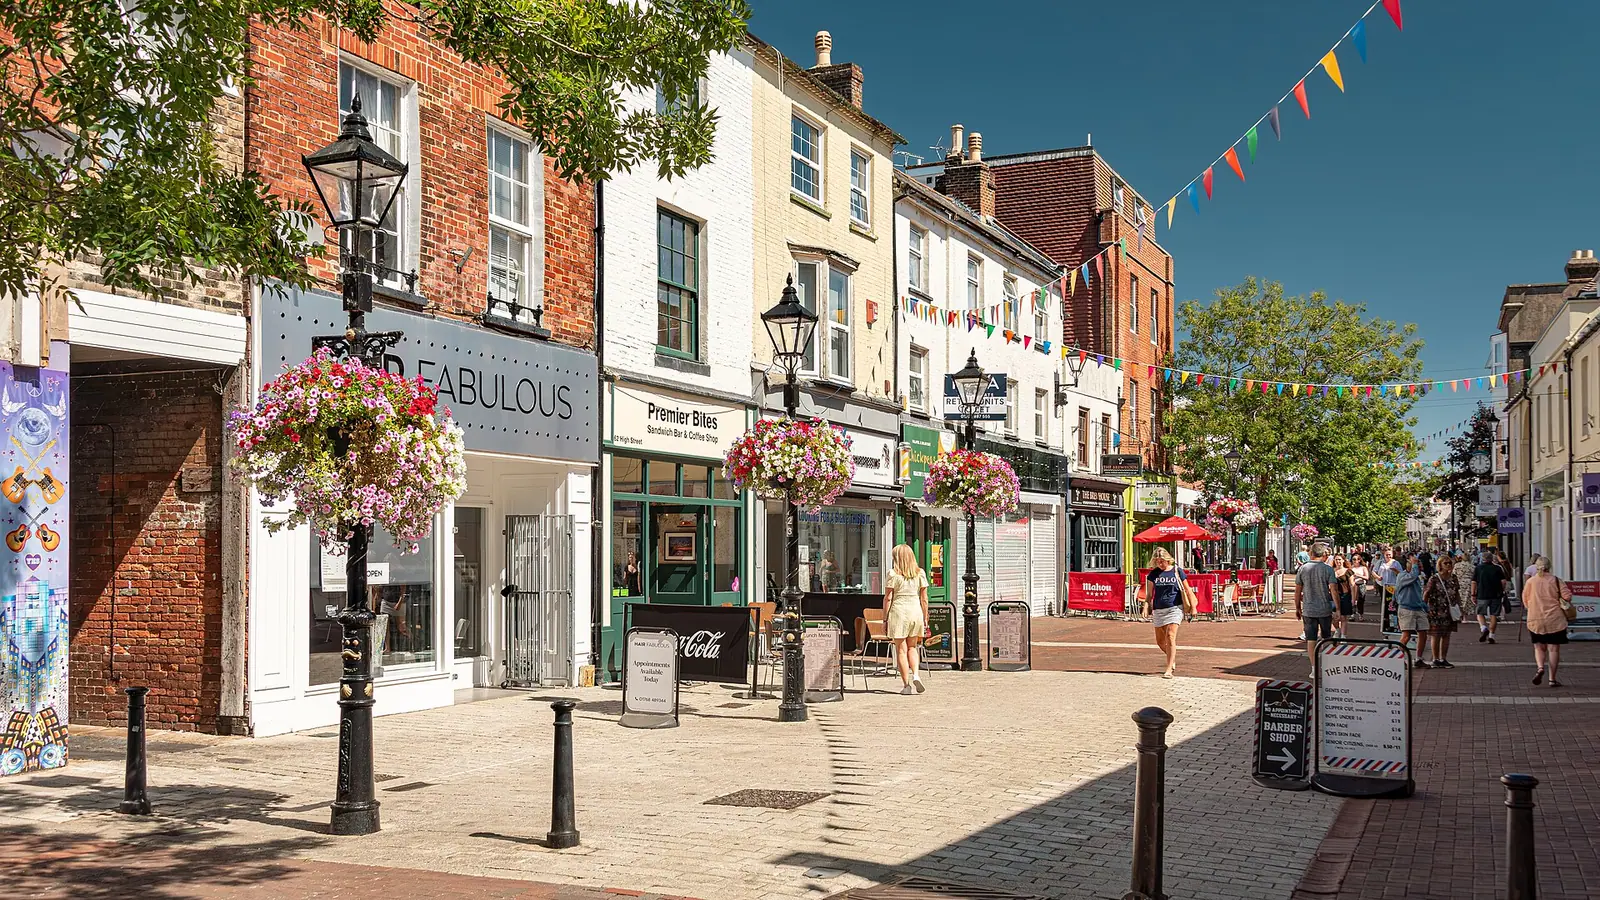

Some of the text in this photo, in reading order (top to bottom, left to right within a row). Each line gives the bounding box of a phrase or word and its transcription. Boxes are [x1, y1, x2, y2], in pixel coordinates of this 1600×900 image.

[418, 360, 573, 420] FABULOUS
[648, 402, 718, 430] Premier Bites
[620, 436, 630, 444] High
[647, 424, 718, 444] Sandwich Bar & Coffee Shop
[367, 570, 382, 578] OPEN
[1082, 583, 1112, 592] Mahou
[1325, 666, 1402, 682] THE MENS ROOM
[1264, 722, 1302, 734] BARBER
[1270, 732, 1296, 743] SHOP
